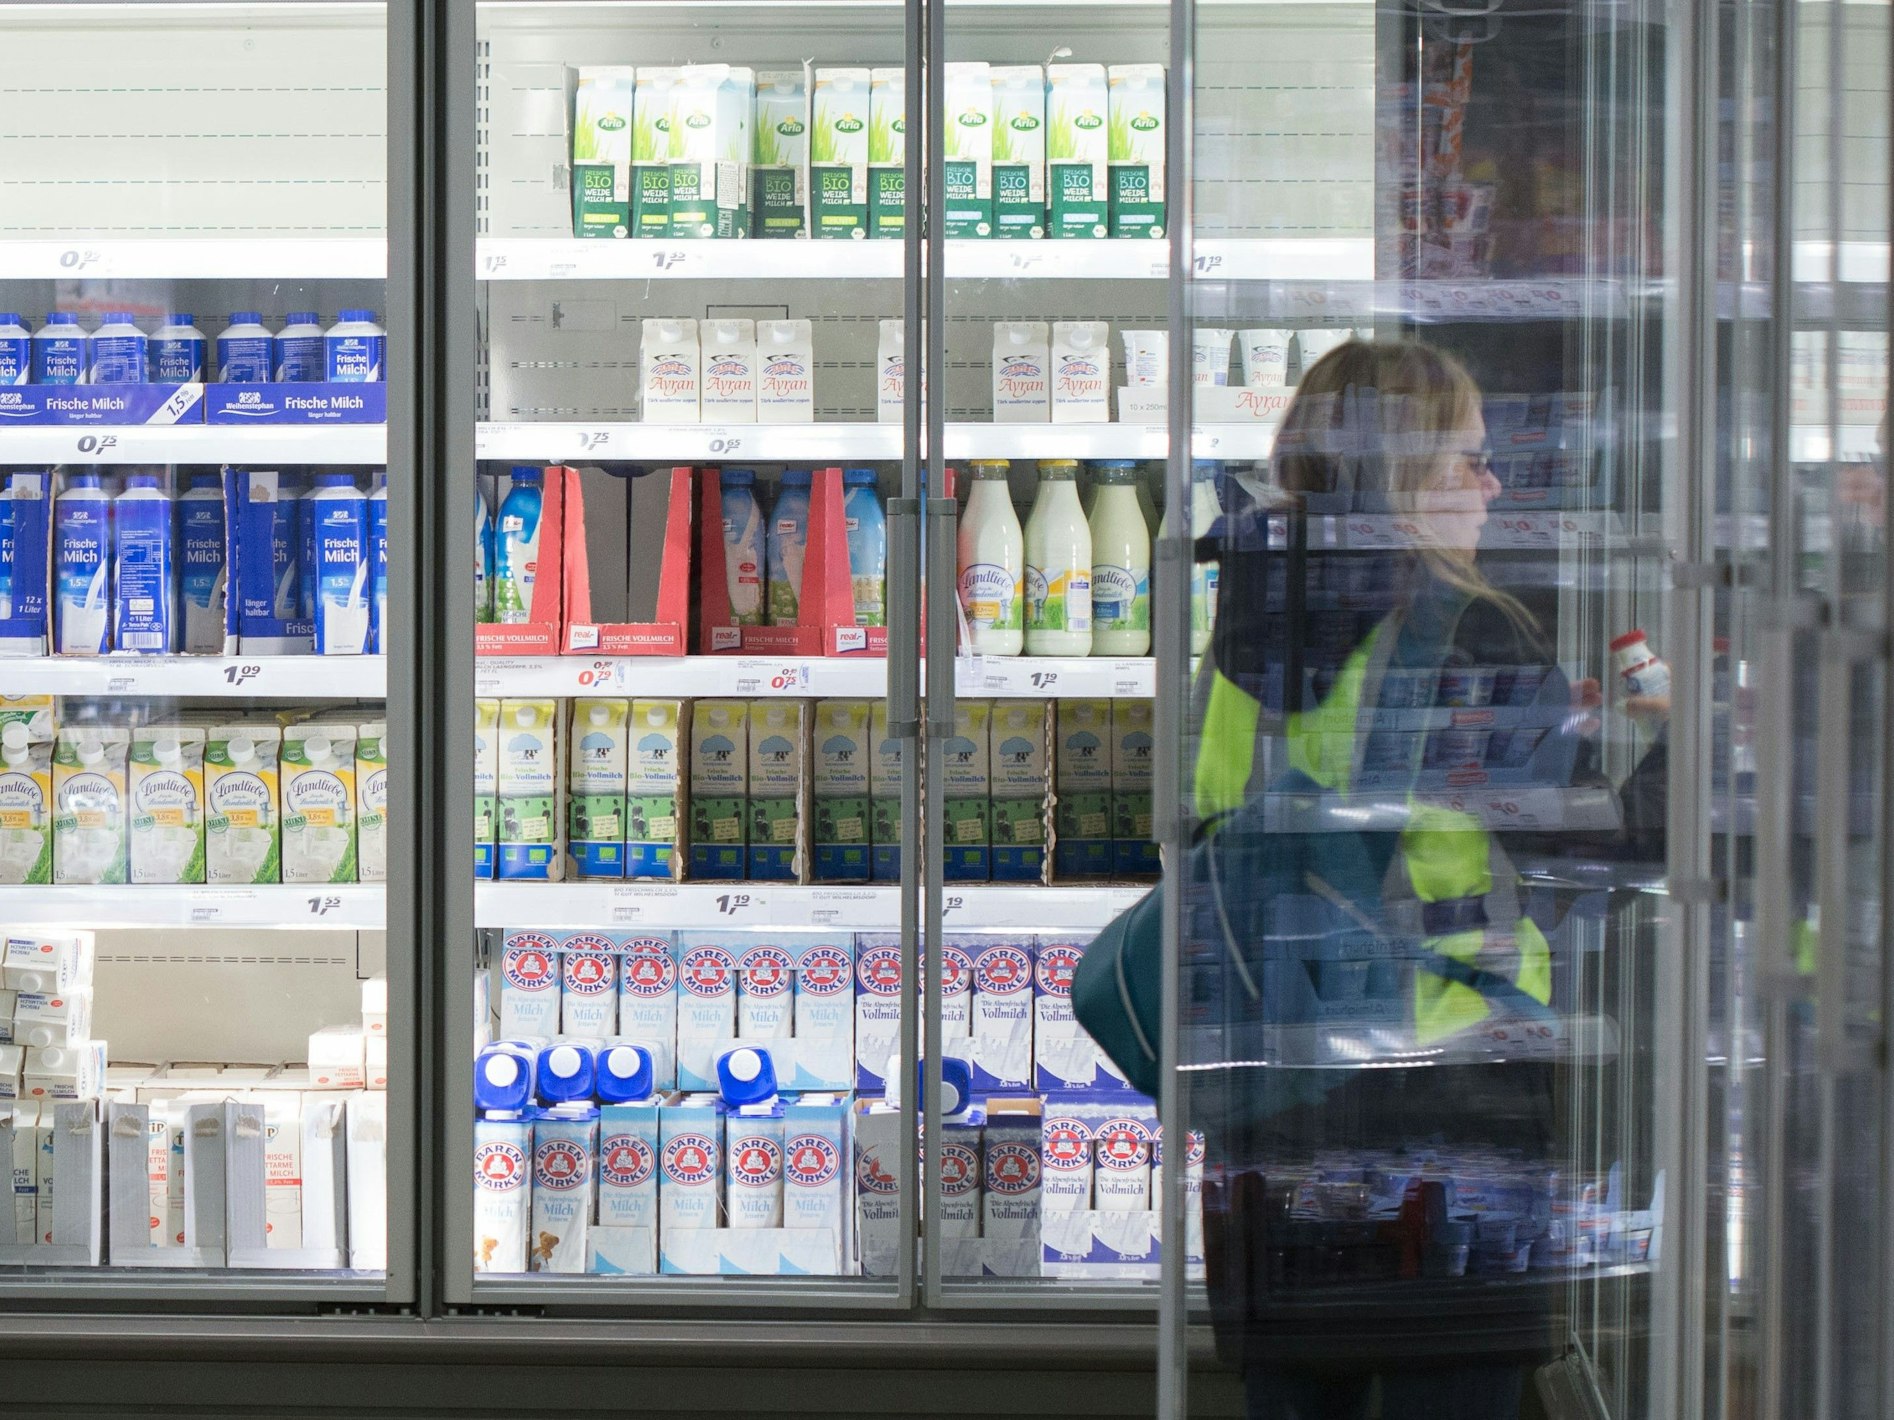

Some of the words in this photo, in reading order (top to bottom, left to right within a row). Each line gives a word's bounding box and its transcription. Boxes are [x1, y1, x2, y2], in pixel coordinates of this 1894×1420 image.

[601, 119, 622, 128] Arla
[688, 116, 708, 125] Arla
[838, 120, 861, 131] Arla
[961, 114, 983, 124] Arla
[1014, 118, 1036, 129] Arla
[1077, 117, 1099, 128] Arla
[1134, 118, 1157, 129] Arla
[779, 123, 801, 134] Arla
[585, 176, 611, 188] BIO
[643, 176, 669, 189] BIO
[674, 174, 698, 186] BIO
[822, 178, 849, 190] BIO
[946, 172, 974, 185] BIO
[1000, 176, 1026, 189] BIO
[1063, 175, 1090, 188] BIO
[1119, 176, 1146, 189] BIO
[585, 188, 611, 196] WEIDE
[642, 189, 668, 197] WEIDE
[673, 187, 697, 195] WEIDE
[765, 180, 792, 193] BIO
[946, 185, 973, 193] WEIDE
[999, 189, 1026, 197] WEIDE
[1063, 187, 1090, 196] WEIDE
[1119, 189, 1146, 197] WEIDE
[765, 193, 791, 201] WEIDE
[822, 190, 849, 198] WEIDE
[1194, 255, 1222, 273] 1,19
[46, 356, 77, 365] Frische
[160, 357, 190, 366] Frische
[336, 354, 367, 363] Frische
[47, 365, 77, 377] Milch
[160, 367, 190, 378] Milch
[336, 364, 367, 375] Milch
[1251, 370, 1282, 387] Ayran
[649, 376, 695, 396] Ayran
[706, 377, 752, 397] Ayran
[762, 377, 808, 397] Ayran
[998, 376, 1044, 398] Ayran
[1056, 376, 1103, 396] Ayran
[46, 397, 89, 410] Frische
[92, 397, 124, 410] Milch
[167, 395, 186, 417] 1,5
[285, 396, 328, 409] Frische
[331, 396, 364, 409] Milch
[76, 434, 118, 455] 0,75
[708, 439, 741, 454] 0,65
[64, 538, 98, 549] Frische
[187, 538, 221, 549] Frische
[324, 538, 359, 549] Frische
[64, 549, 98, 563] Milch
[187, 550, 221, 563] Milch
[324, 548, 359, 563] Milch
[25, 596, 36, 604] 12
[245, 599, 267, 609] länger
[24, 605, 42, 614] Liter
[245, 608, 270, 617] haltbar
[223, 665, 261, 686] 1,09
[578, 670, 611, 687] 0,79
[1030, 672, 1058, 689] 1,19
[771, 676, 796, 690] 0,75
[572, 771, 623, 779] Bio-Vollmilch
[692, 774, 743, 782] Bio-Vollmilch
[141, 779, 192, 797] Landliebe
[215, 780, 265, 798] Landliebe
[292, 779, 342, 797] Landliebe
[361, 867, 372, 876] 1,5
[308, 897, 341, 915] 1,55
[716, 894, 750, 916] 1,19
[565, 937, 611, 951] BÄREN
[623, 940, 670, 955] BÄREN
[685, 950, 732, 968] BÄREN
[743, 950, 790, 968] BÄREN
[801, 950, 850, 968] BÄREN
[979, 950, 1026, 968] BÄREN
[625, 976, 671, 994] MARKE
[685, 976, 731, 994] MARKE
[800, 975, 846, 993] MARKE
[980, 973, 1024, 992] MARKE
[573, 1008, 602, 1021] Milch
[982, 1008, 1027, 1019] Vollmilch
[1100, 1122, 1146, 1141] BÄREN
[538, 1143, 584, 1162] BÄREN
[602, 1138, 649, 1157] BÄREN
[667, 1137, 713, 1156] BÄREN
[733, 1140, 778, 1158] BÄREN
[787, 1138, 833, 1157] BÄREN
[988, 1146, 1036, 1165] BÄREN
[1043, 1151, 1089, 1168] MARKE
[1099, 1151, 1145, 1169] MARKE
[536, 1170, 583, 1187] MARKE
[602, 1165, 648, 1182] MARKE
[667, 1163, 713, 1182] MARKE
[732, 1166, 778, 1183] MARKE
[786, 1164, 833, 1183] MARKE
[474, 1171, 522, 1189] MARKE
[988, 1173, 1035, 1191] MARKE
[1100, 1183, 1144, 1195] Vollmilch
[543, 1203, 574, 1216] Milch
[610, 1200, 641, 1212] Milch
[739, 1201, 771, 1212] Milch
[991, 1207, 1038, 1219] Vollmilch
